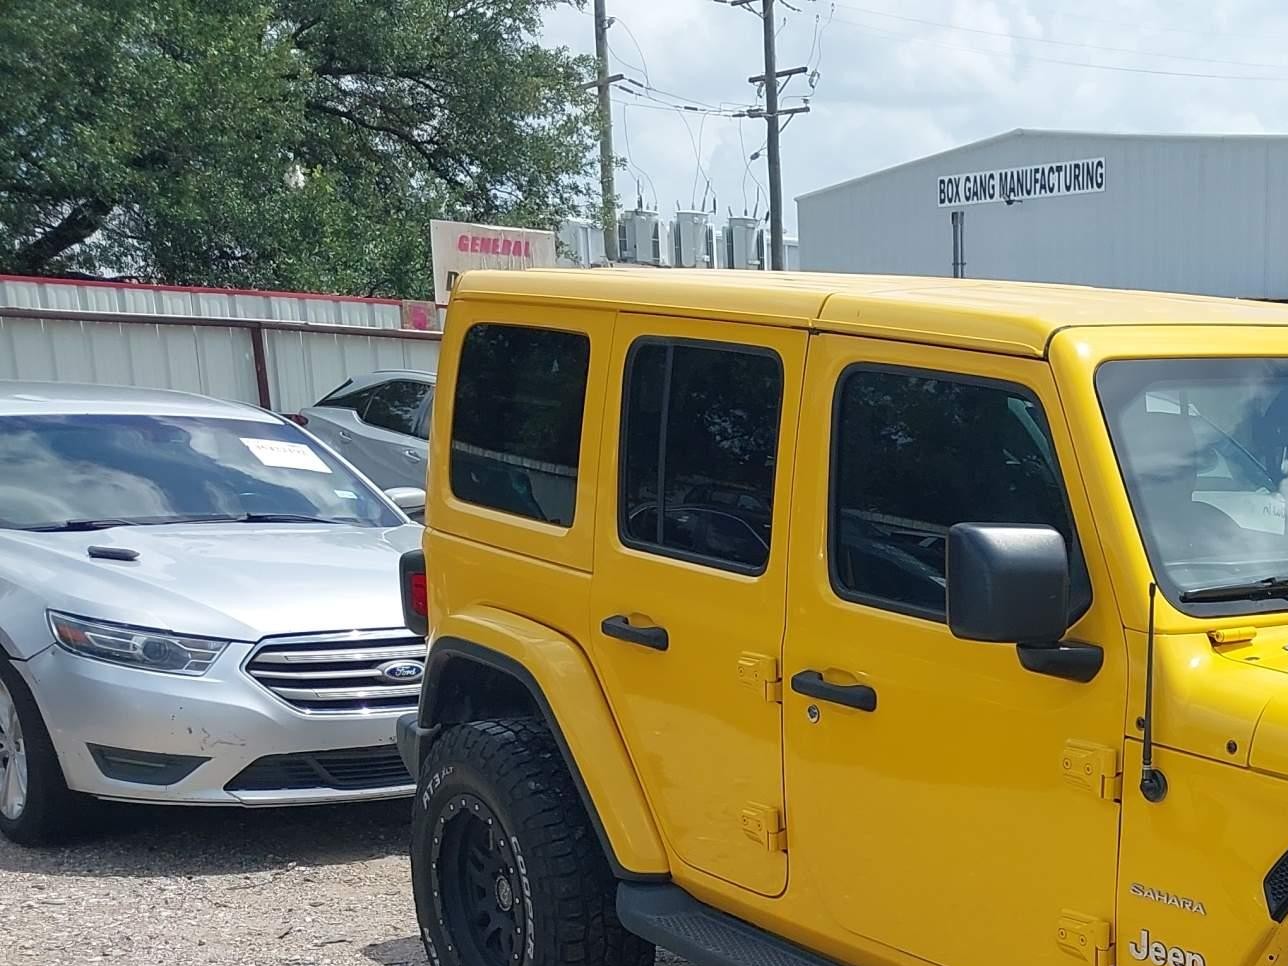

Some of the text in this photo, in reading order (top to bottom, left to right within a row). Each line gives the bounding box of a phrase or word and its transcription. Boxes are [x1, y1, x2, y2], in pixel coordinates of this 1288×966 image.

[939, 160, 1104, 204] BOX GANG MANUFACTURING
[395, 666, 417, 676] Ford
[511, 836, 535, 960] COOPER
[1129, 883, 1207, 916] SAHARA
